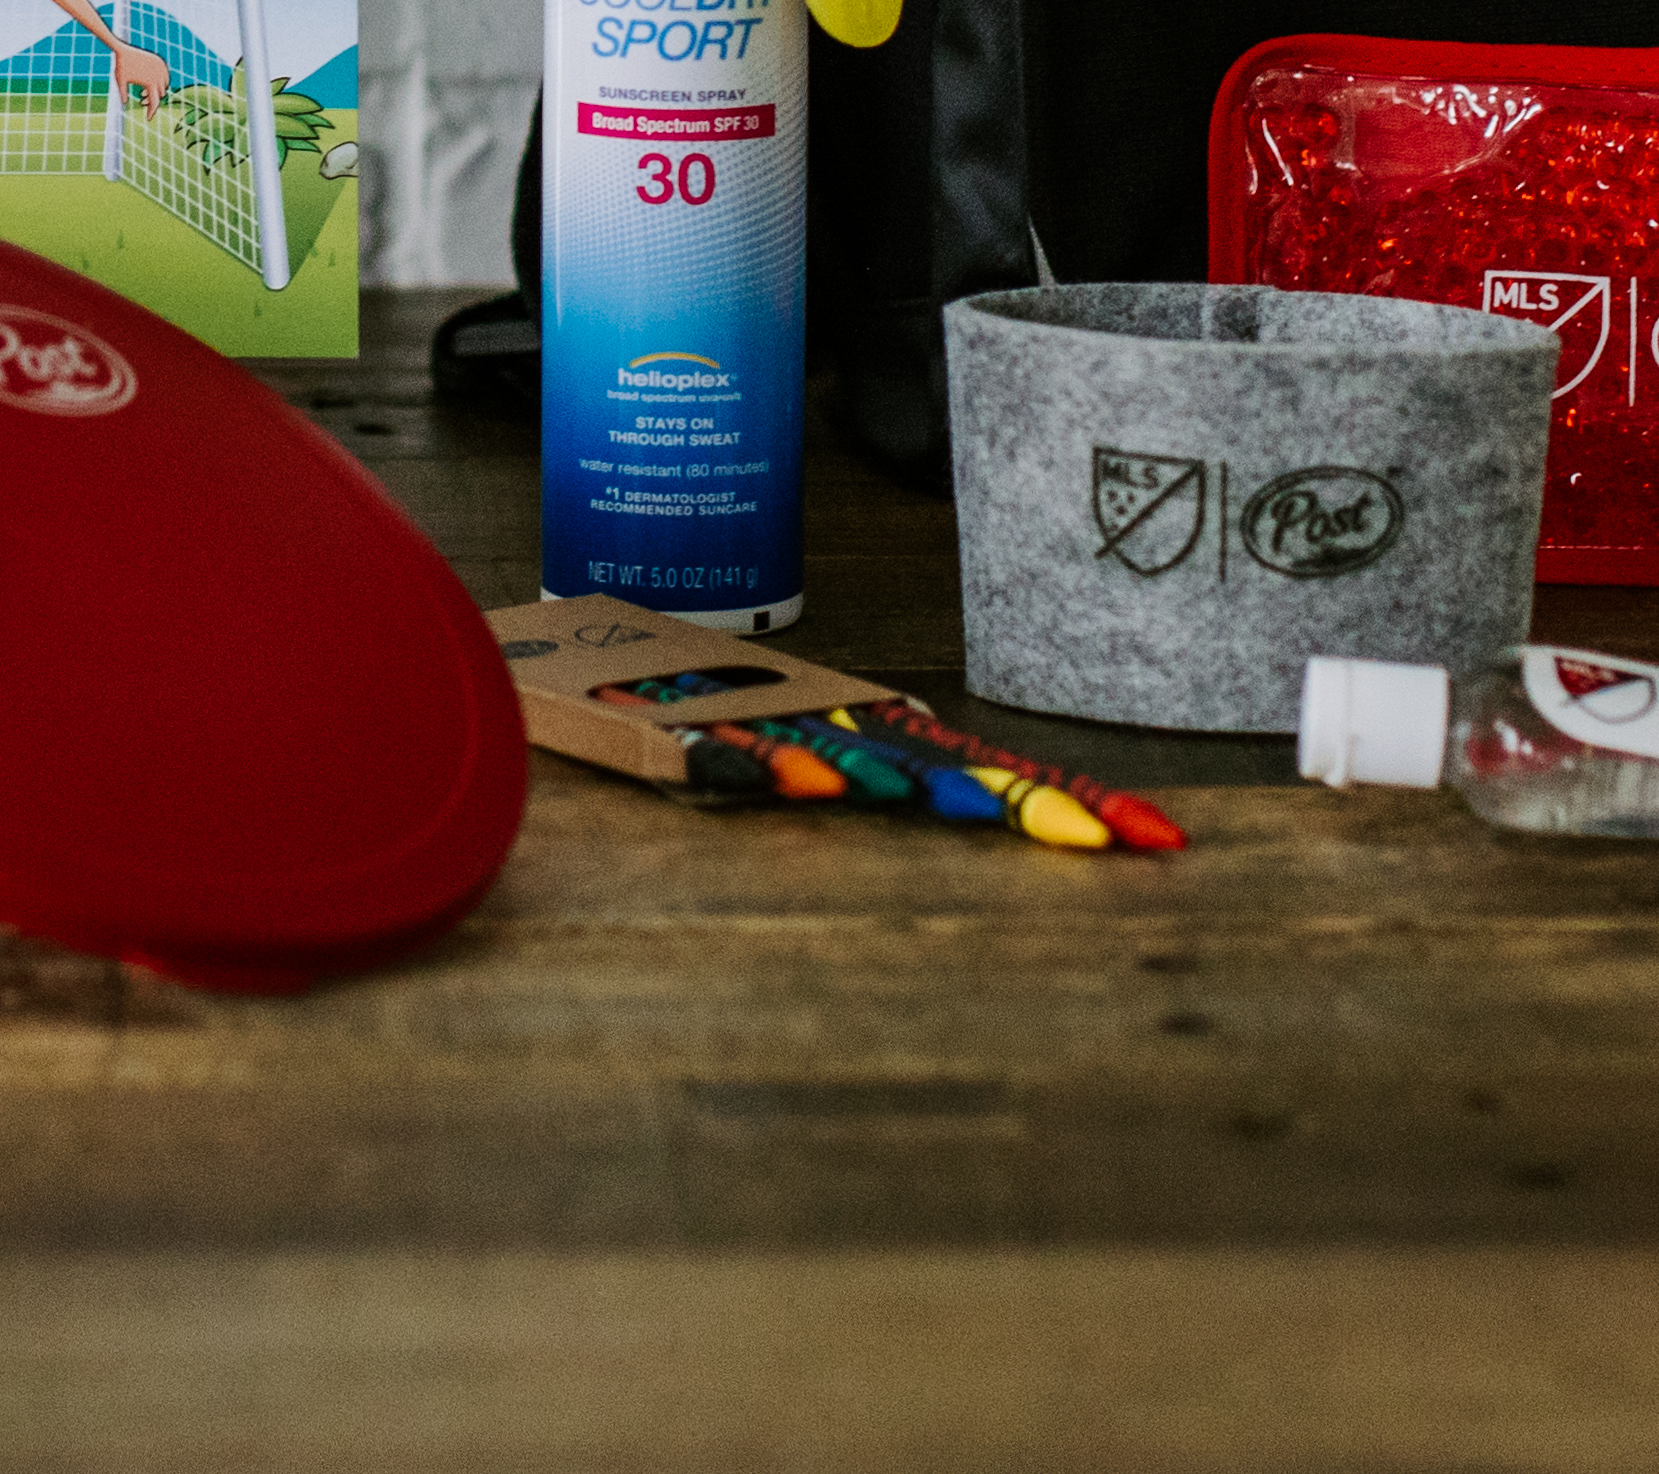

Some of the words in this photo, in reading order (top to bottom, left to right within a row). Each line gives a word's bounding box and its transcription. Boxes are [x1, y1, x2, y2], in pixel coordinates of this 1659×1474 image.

[592, 16, 763, 62] SPORT
[599, 86, 692, 102] SUNSCREEN
[697, 88, 747, 102] SPRAY
[592, 112, 633, 132] Broad
[637, 115, 710, 135] Spectrum
[714, 117, 741, 132] SPF
[743, 115, 759, 130] 30
[635, 152, 717, 206] 30
[1493, 281, 1559, 311] MLS
[618, 368, 730, 391] helioplex
[635, 416, 687, 430] STAYS
[690, 418, 714, 429] ON
[609, 430, 685, 446] THROUGH
[689, 432, 741, 446] SWEAT
[579, 458, 614, 472] water
[618, 464, 682, 477] resistant
[687, 464, 709, 480] (80
[713, 460, 770, 476] minutes)
[1101, 459, 1159, 490] MLS
[590, 499, 693, 516] RECOMMENDED
[698, 502, 757, 516] SUNCARE
[625, 491, 736, 504] DERMATOLOGIST
[1271, 490, 1371, 553] Post
[588, 560, 615, 584] NET
[618, 565, 647, 587] WT.
[651, 567, 677, 588] 5.0
[683, 567, 704, 588] OZ
[709, 566, 742, 589] (141
